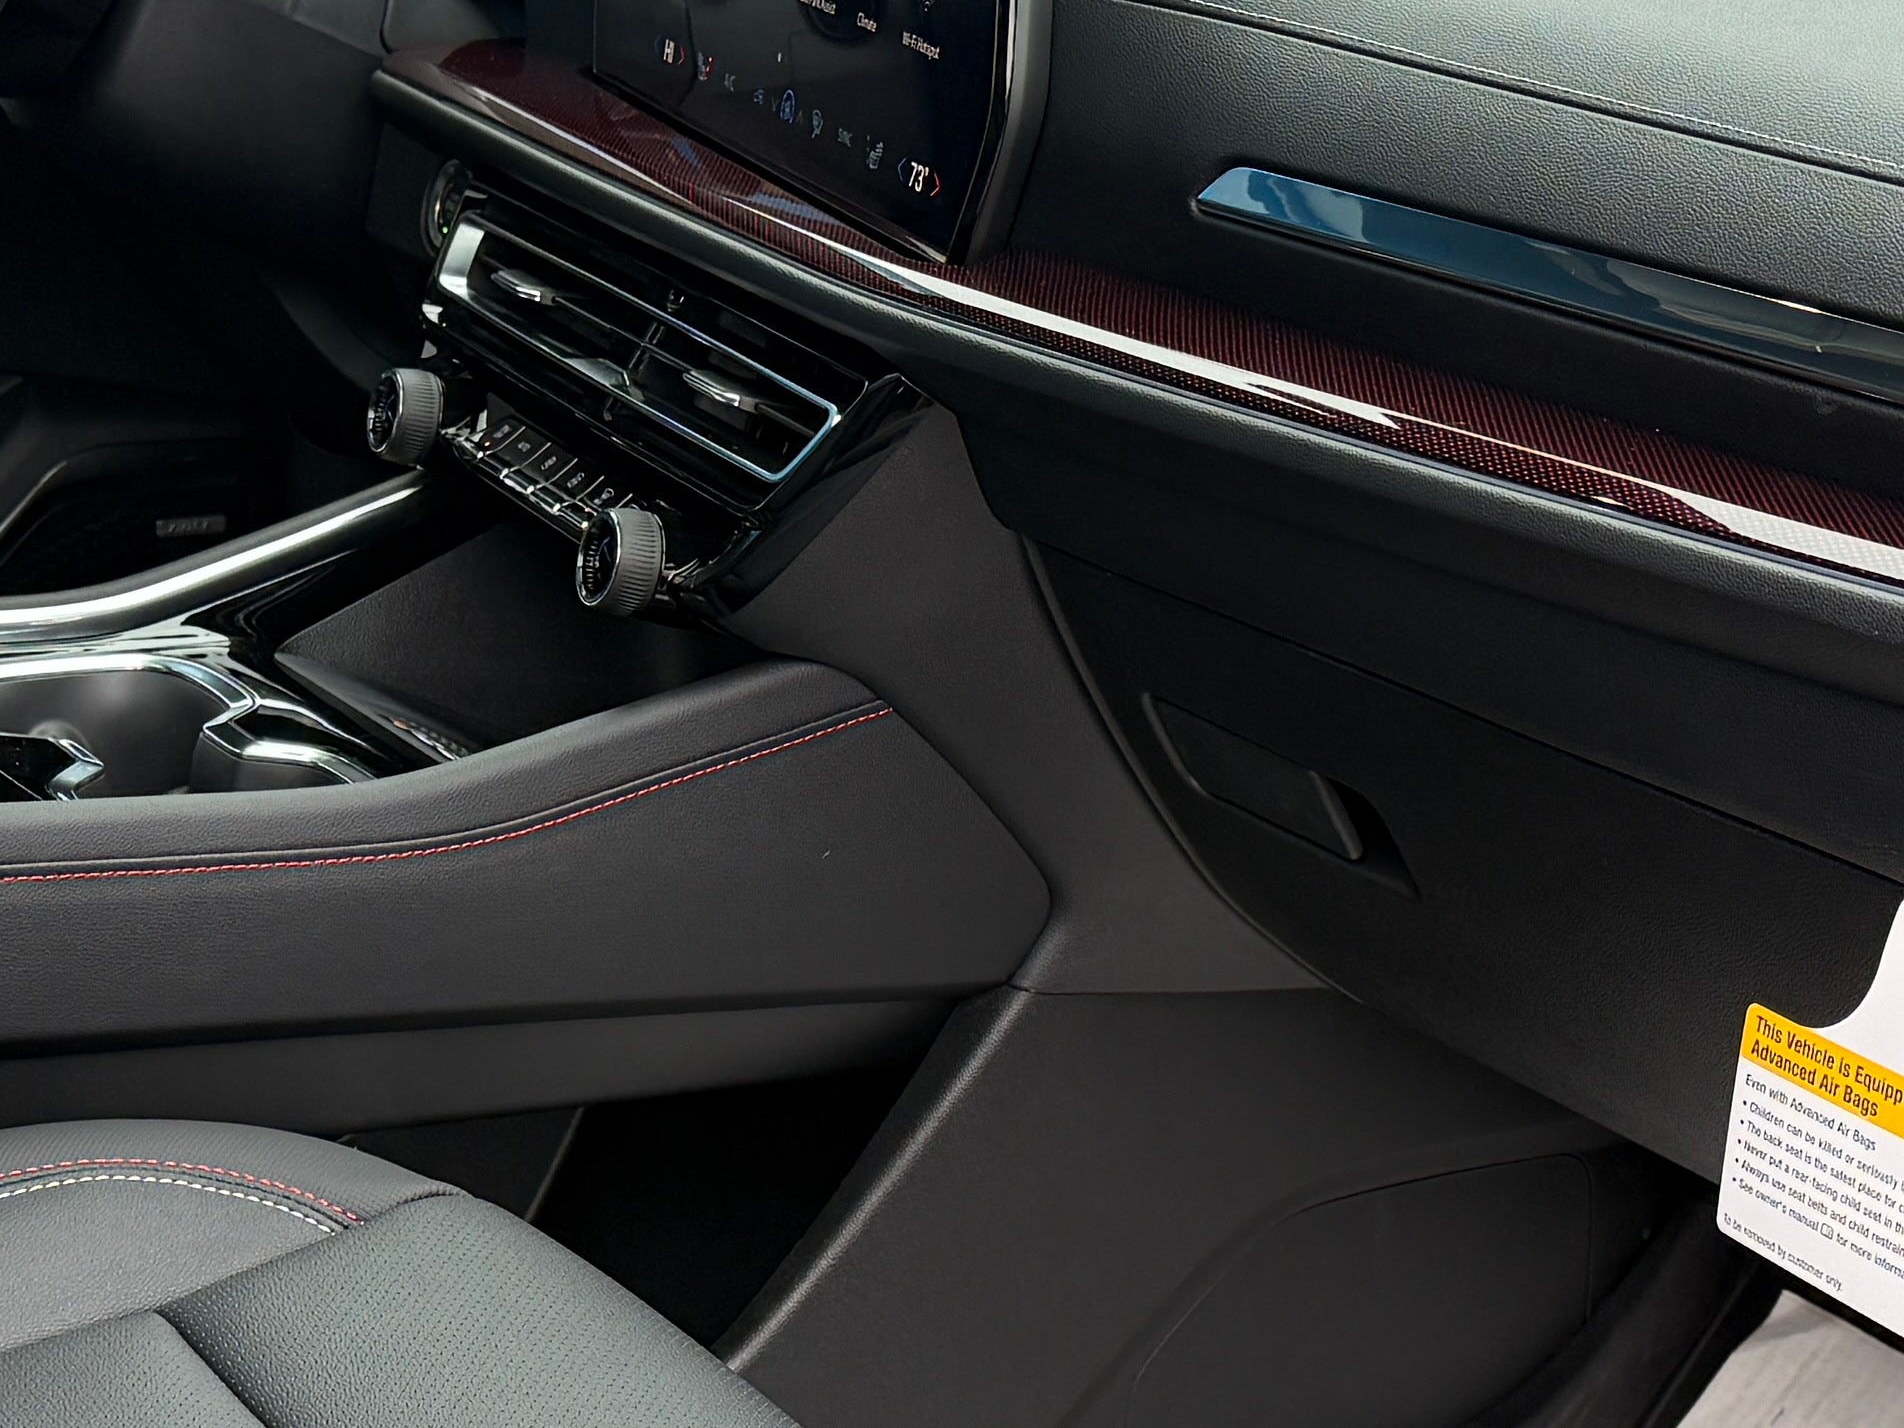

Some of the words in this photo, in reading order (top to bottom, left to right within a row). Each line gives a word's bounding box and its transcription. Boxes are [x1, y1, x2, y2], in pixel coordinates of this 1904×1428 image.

[1750, 1037, 1816, 1086] Advanced
[1819, 1072, 1840, 1098] Air
[1842, 1084, 1879, 1121] Bags
[1754, 1014, 1783, 1045] This
[1786, 1031, 1835, 1071] Vehicle
[1837, 1057, 1851, 1079] is
[1745, 1074, 1766, 1094] Even
[1769, 1087, 1788, 1106] with
[1790, 1098, 1834, 1130] Advanced
[1837, 1121, 1850, 1138] Air
[1852, 1129, 1876, 1153] Bags
[1749, 1101, 1784, 1129] Children
[1786, 1122, 1802, 1139] can
[1805, 1131, 1816, 1145] be
[1818, 1138, 1842, 1160] killed
[1844, 1153, 1854, 1166] or
[1856, 1157, 1898, 1190] seriously
[1743, 1140, 1766, 1161] Never
[1768, 1154, 1782, 1171] put
[1784, 1164, 1790, 1174] a
[1791, 1166, 1838, 1202] rear-facing
[1839, 1191, 1861, 1212] child
[1862, 1204, 1882, 1223] seat
[1884, 1215, 1892, 1229] in
[1746, 1121, 1761, 1138] The
[1763, 1130, 1782, 1149] back
[1784, 1141, 1803, 1160] seat
[1804, 1152, 1812, 1165] is
[1814, 1156, 1827, 1173] the
[1829, 1165, 1856, 1188] safest
[1857, 1180, 1882, 1204] place
[1884, 1193, 1896, 1209] for
